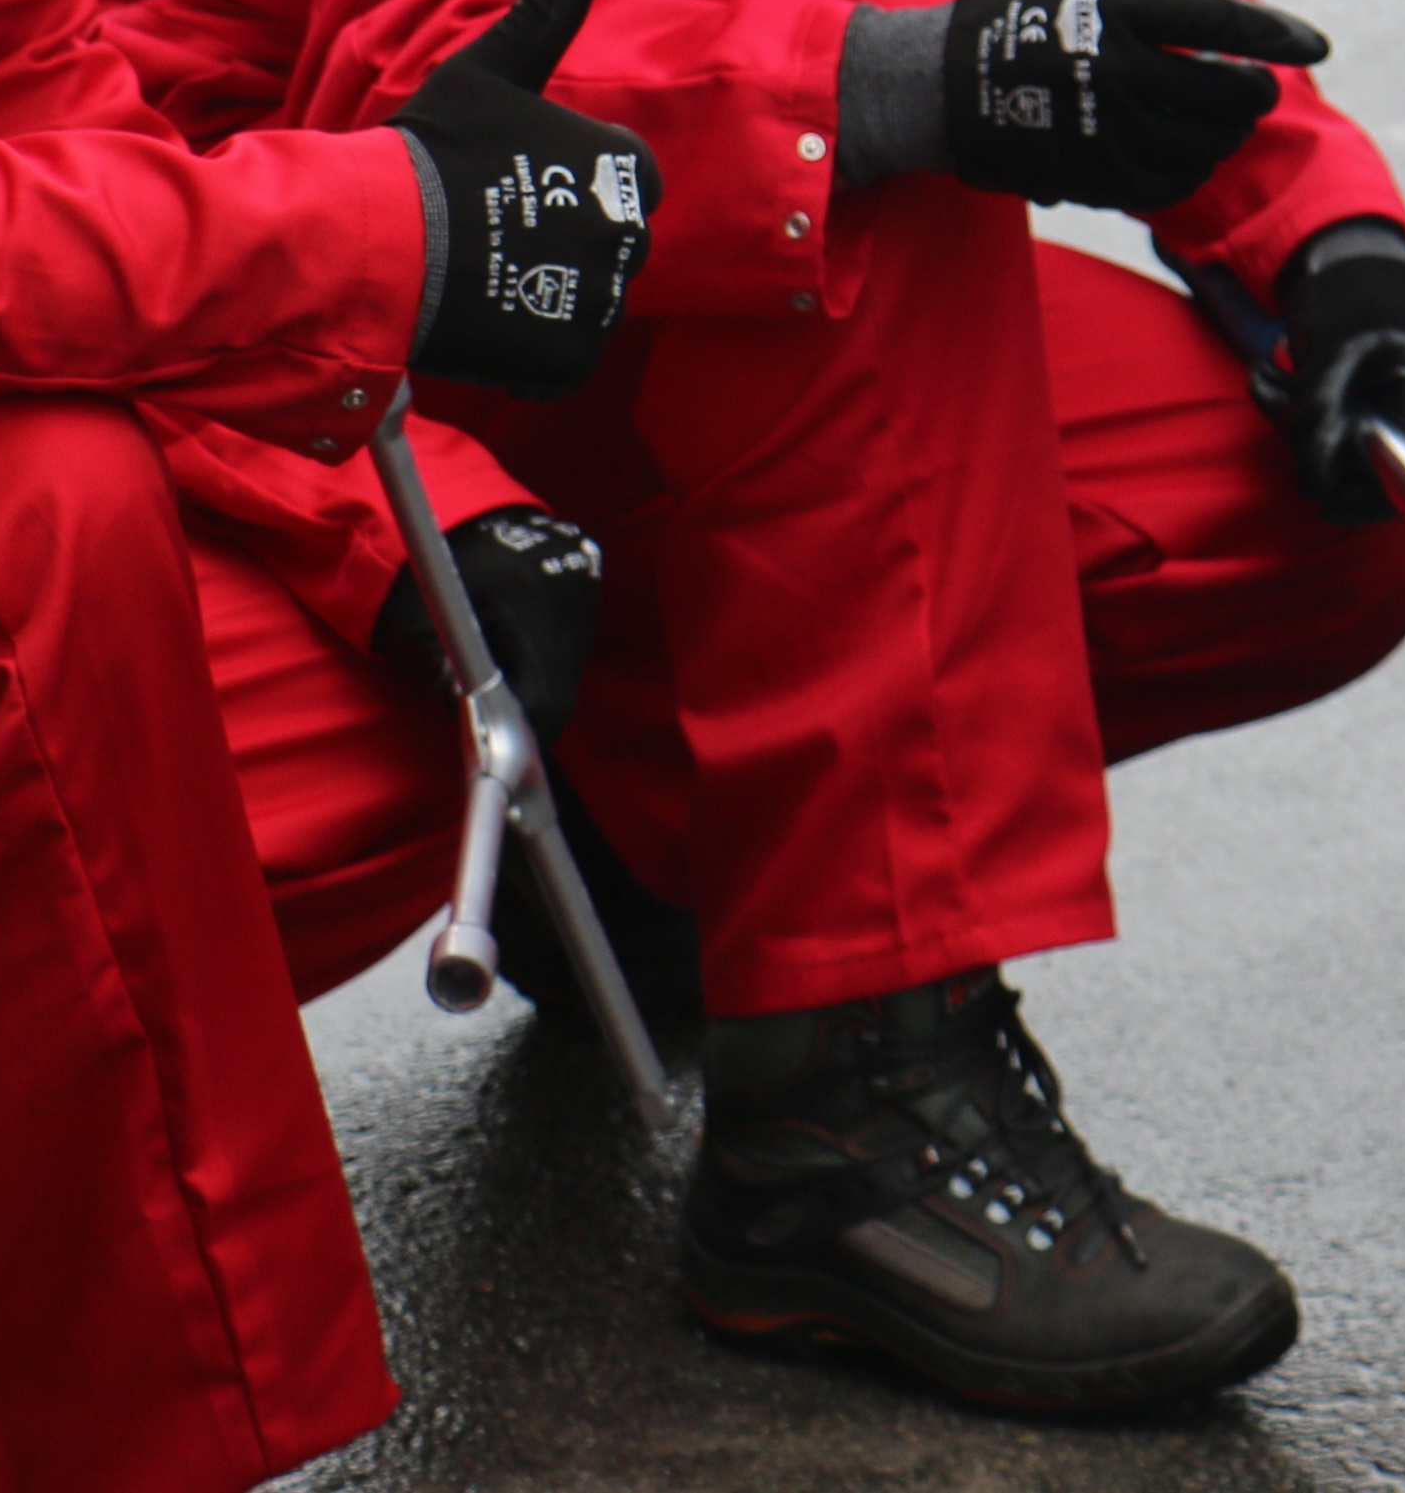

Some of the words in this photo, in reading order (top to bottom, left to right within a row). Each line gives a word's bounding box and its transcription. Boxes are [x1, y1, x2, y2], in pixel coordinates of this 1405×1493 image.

[485, 187, 503, 225] Made
[541, 165, 579, 207] CE
[488, 252, 503, 297] Korea
